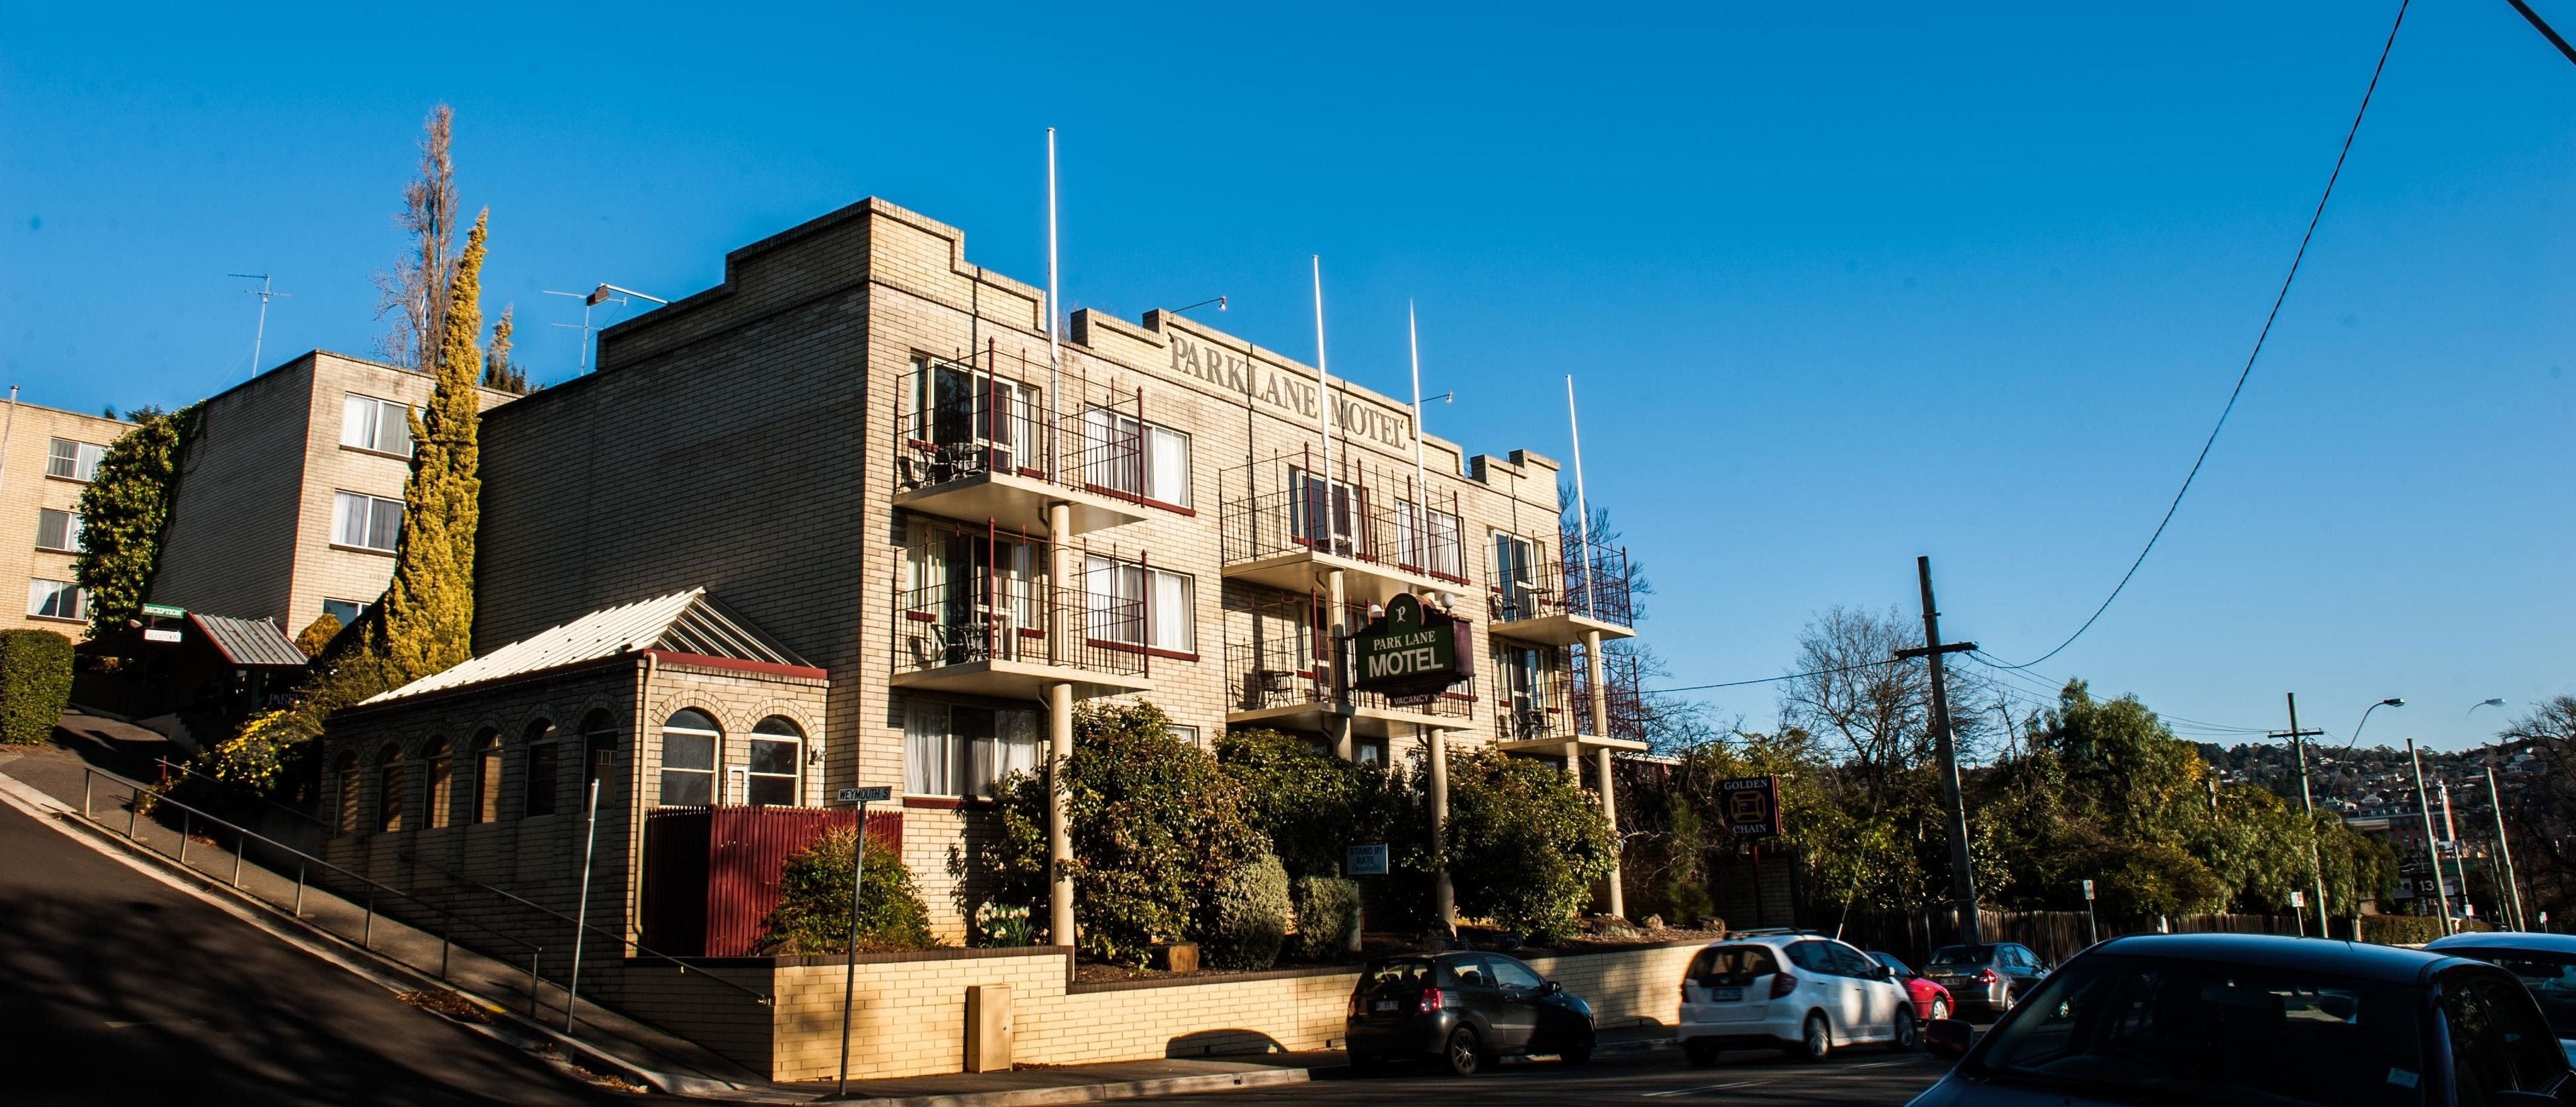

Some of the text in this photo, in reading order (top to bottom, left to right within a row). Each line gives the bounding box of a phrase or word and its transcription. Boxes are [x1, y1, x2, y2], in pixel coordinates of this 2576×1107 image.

[1328, 393, 1406, 451] MOTEL
[1373, 631, 1436, 651] PARK LANE
[1368, 646, 1444, 678] MOTEL
[1394, 694, 1430, 705] VACANCY
[1724, 779, 1768, 790] GOLDEN
[839, 788, 880, 800] WEYMOUTH
[1733, 824, 1766, 833] CHAIN
[1350, 846, 1384, 855] STAND BY
[1356, 856, 1375, 865] RATE
[2418, 880, 2435, 892] 13
